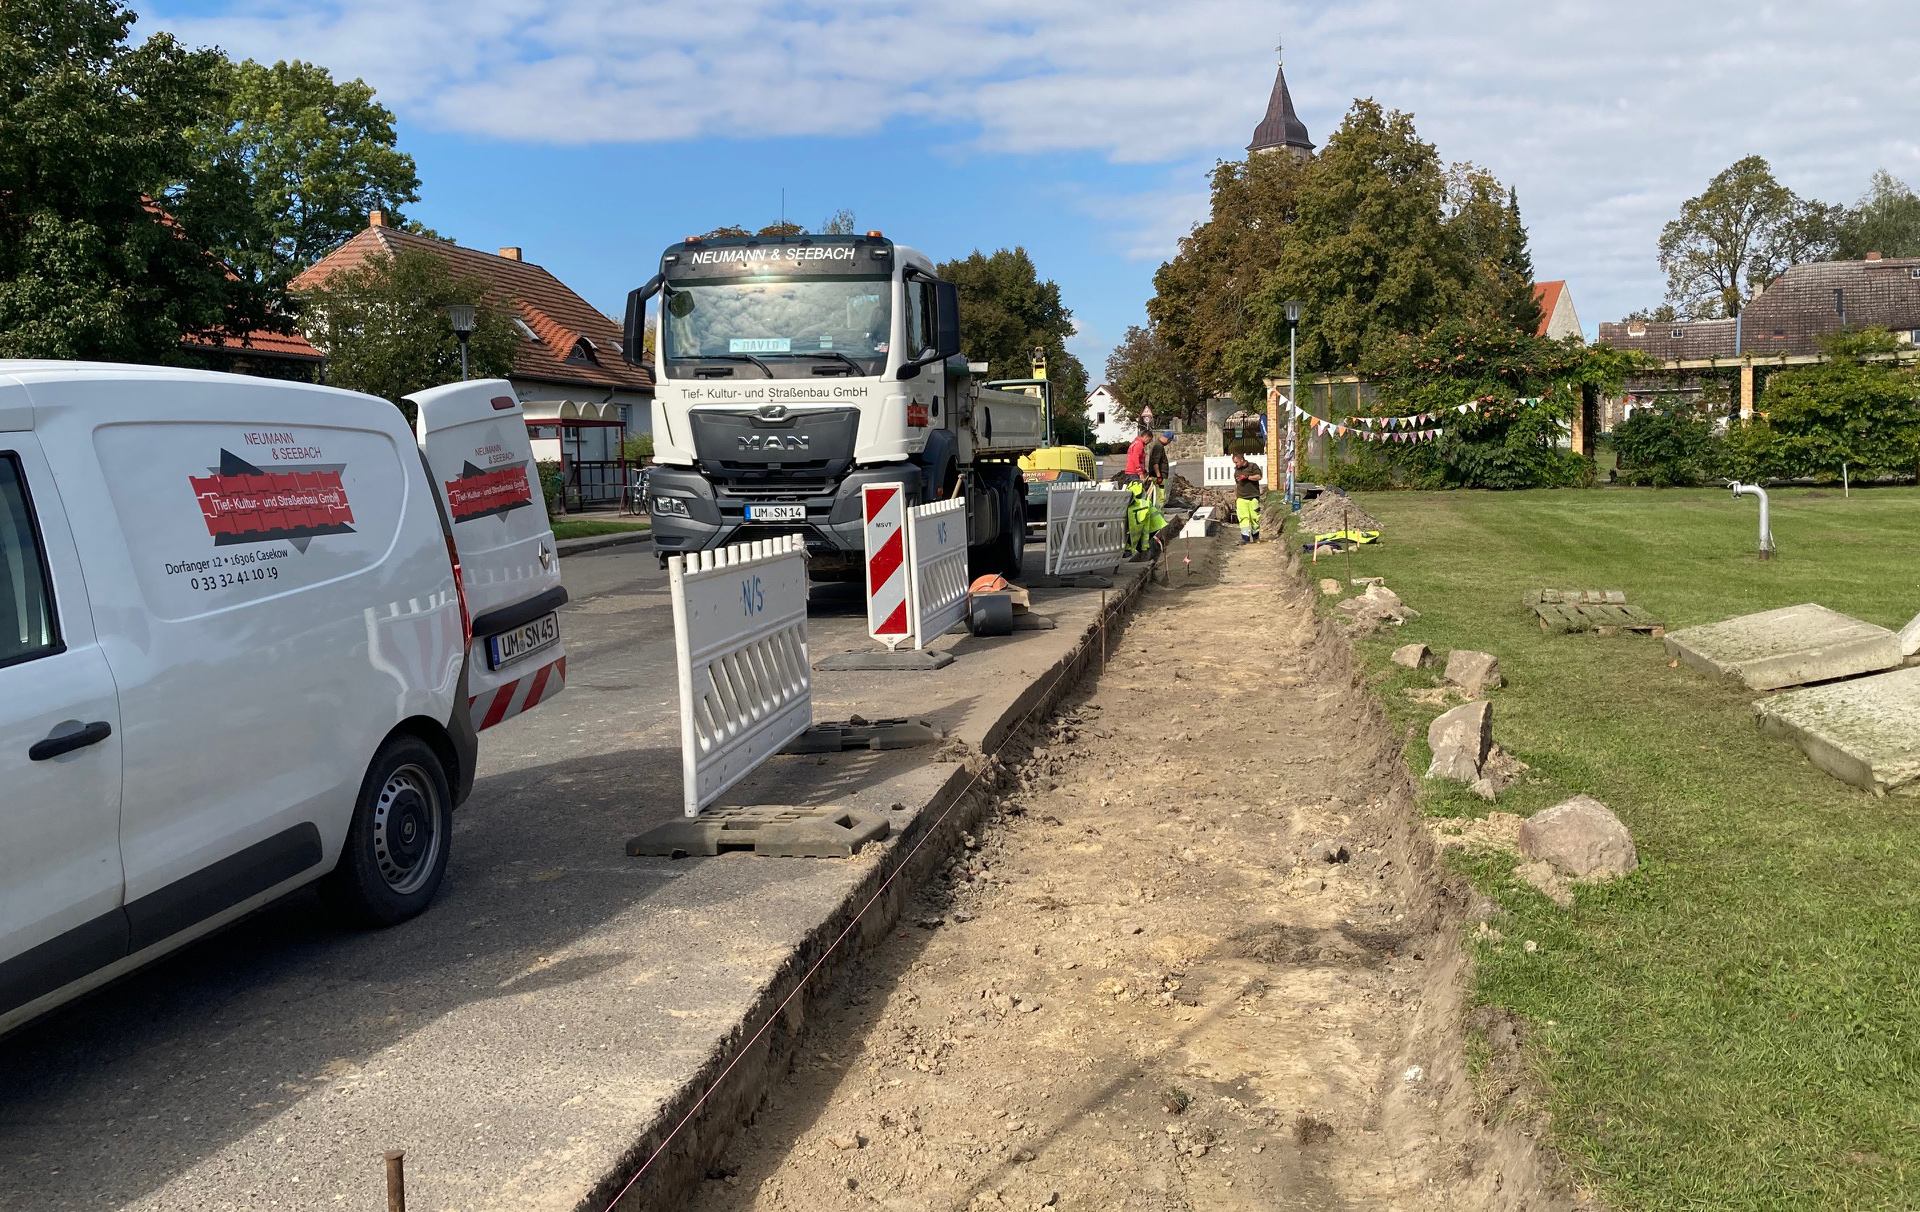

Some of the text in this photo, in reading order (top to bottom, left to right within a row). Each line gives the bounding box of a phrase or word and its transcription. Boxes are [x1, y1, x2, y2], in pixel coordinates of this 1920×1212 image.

[691, 247, 856, 265] NEUMANN & SEEBACH
[681, 386, 868, 399] Tief- Kultur- und Straßenbau GmbH
[244, 432, 295, 445] NEUMANN
[737, 435, 809, 451] MAN
[271, 447, 323, 460] & SEEBACH
[475, 444, 502, 456] NEUMANN
[488, 452, 515, 464] & SEEBACH
[262, 496, 278, 507] und
[277, 494, 318, 506] Straßenbau
[754, 507, 802, 518] UM SN 14
[165, 548, 288, 575] Dorfanger 12 16306 Casekow
[190, 566, 278, 591] 0 33 32 41 10 19
[502, 632, 520, 658] UM
[525, 623, 541, 648] SN
[541, 618, 554, 640] 45
